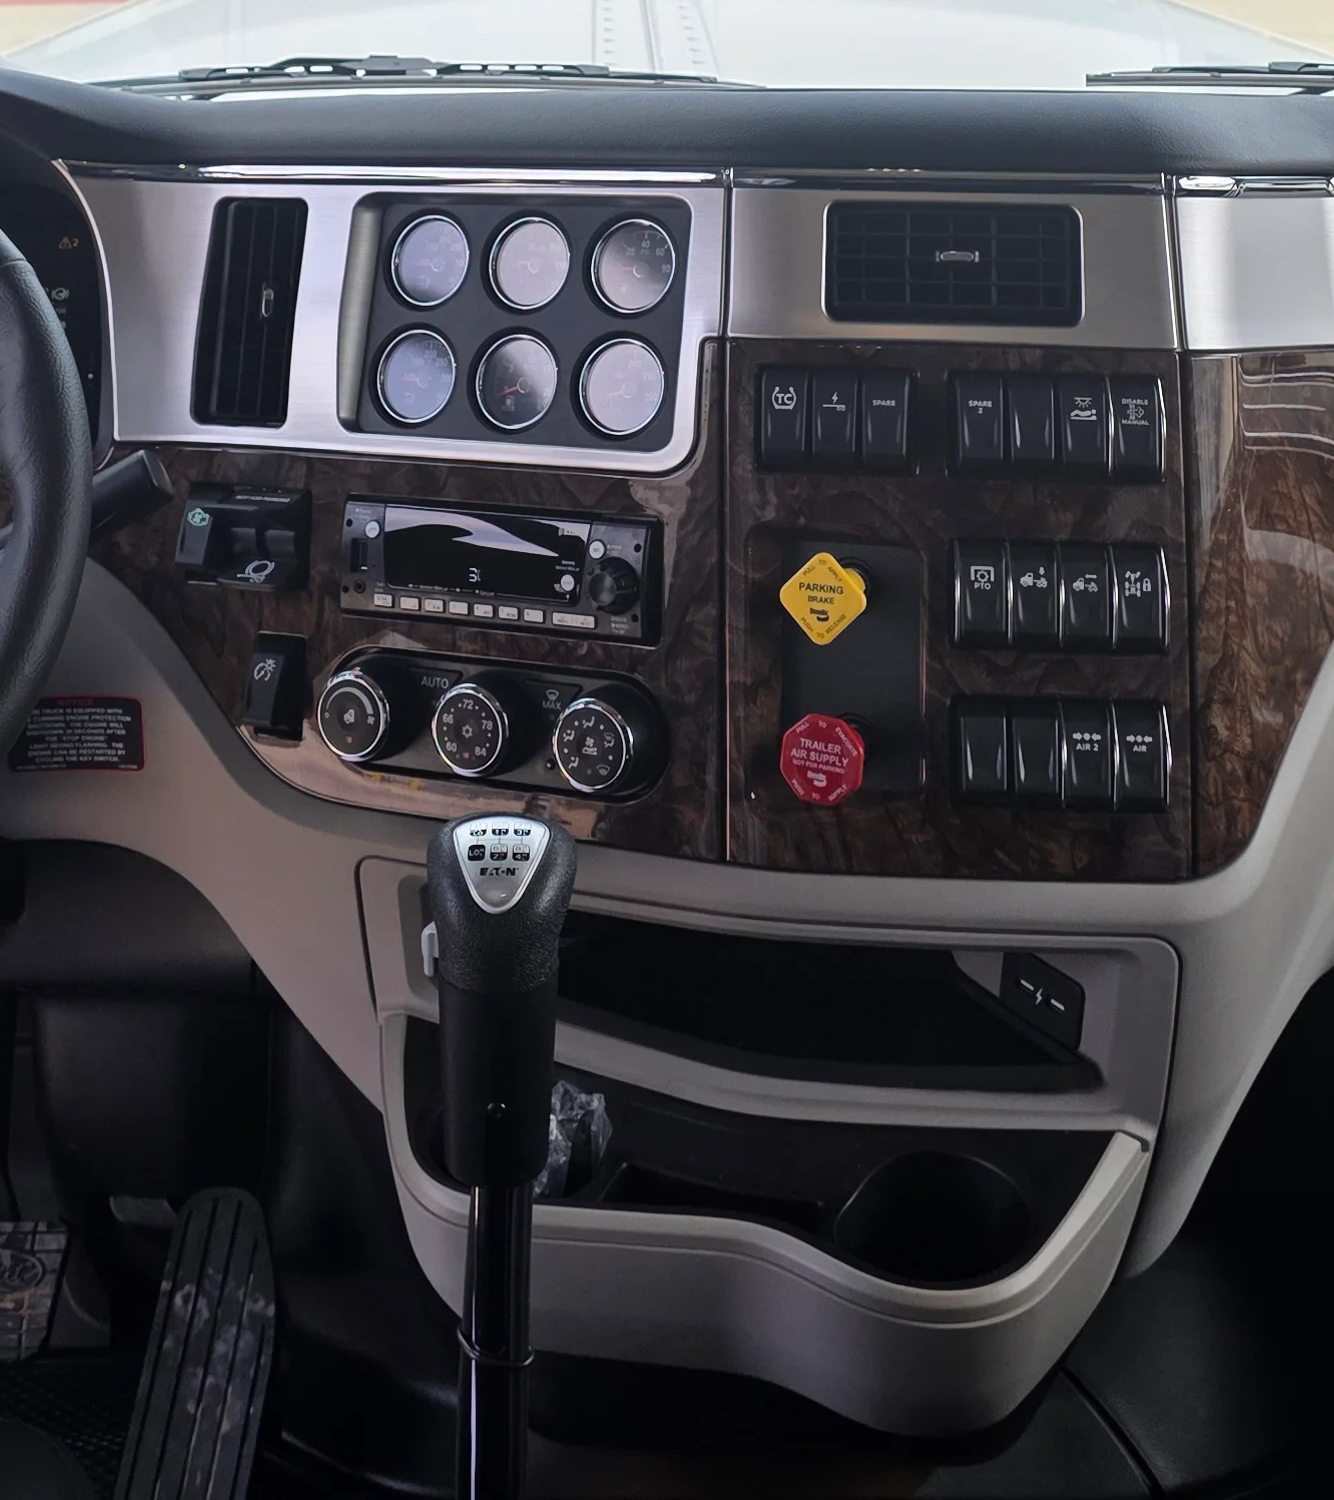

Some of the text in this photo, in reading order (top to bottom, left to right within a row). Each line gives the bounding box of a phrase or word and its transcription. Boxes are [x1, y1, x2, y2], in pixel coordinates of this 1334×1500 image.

[641, 240, 651, 249] 40
[626, 247, 665, 257] 20 60
[661, 264, 671, 273] 80
[776, 393, 793, 405] TC
[872, 399, 896, 407] SPARE
[968, 400, 993, 408] SPARE
[1121, 398, 1149, 406] DISABLE
[1121, 419, 1150, 427] MANUAL
[827, 566, 843, 582] APPLY
[798, 582, 844, 595] PARKING
[974, 582, 992, 591] PTO
[807, 595, 835, 605] BRAKE
[825, 613, 847, 634] RELEASE
[421, 676, 450, 689] AUTO
[462, 699, 474, 710] 72
[543, 701, 562, 711] MAX
[442, 713, 454, 724] 66
[481, 719, 494, 731] 78
[819, 721, 827, 729] TO
[835, 726, 858, 757] EVACUATE
[446, 742, 458, 753] 60
[800, 737, 842, 755] TRAILER
[1076, 743, 1099, 751] AIR 2
[475, 746, 487, 758] 84
[790, 748, 850, 768] AIR SUPPLY
[792, 758, 845, 774] NOT FOR PARKING
[811, 792, 820, 800] TO
